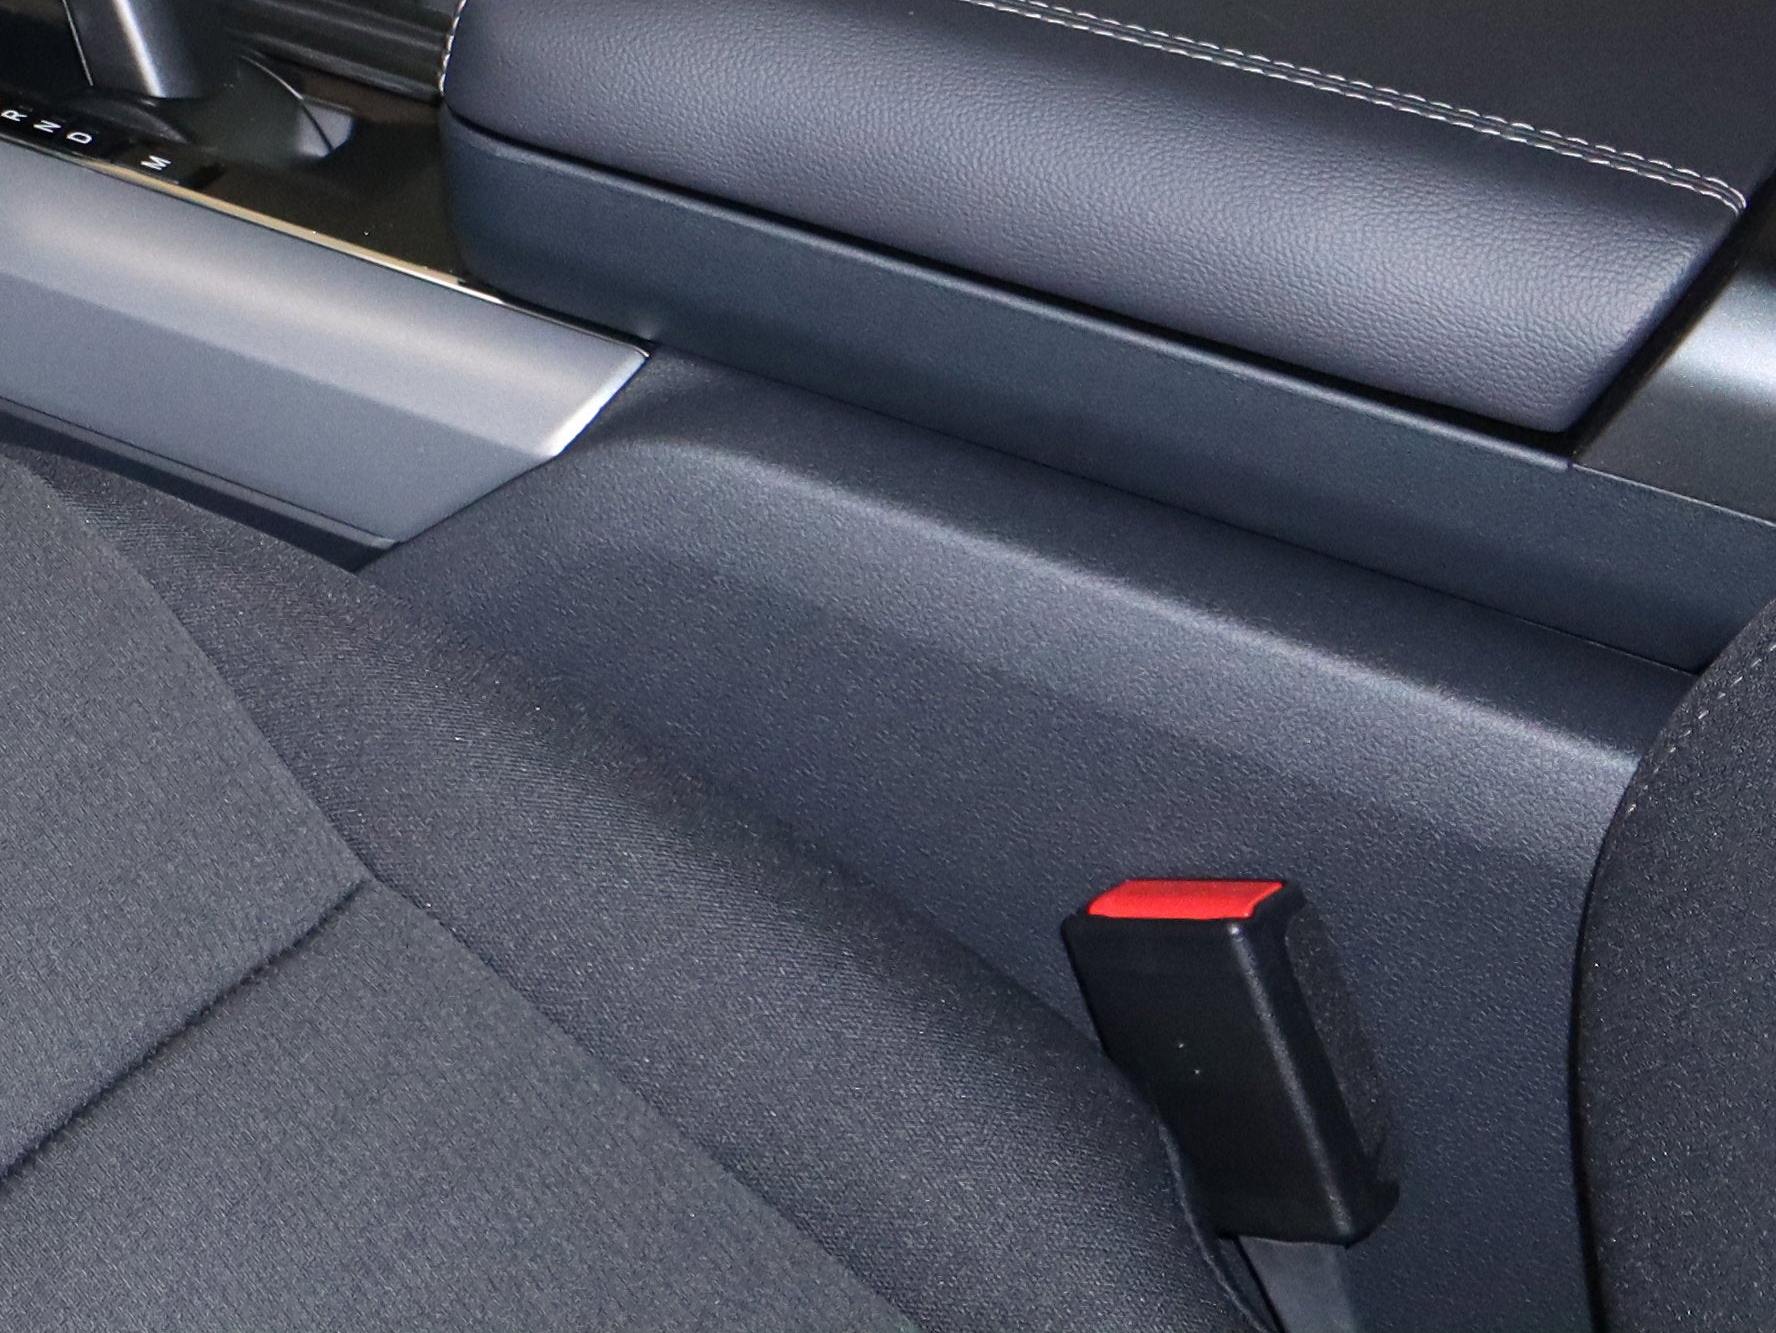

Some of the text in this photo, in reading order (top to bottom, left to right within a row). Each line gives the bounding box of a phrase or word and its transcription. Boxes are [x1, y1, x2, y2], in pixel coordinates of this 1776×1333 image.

[0, 109, 28, 122] R
[33, 119, 61, 133] N
[66, 131, 92, 145] D
[141, 155, 172, 171] M
